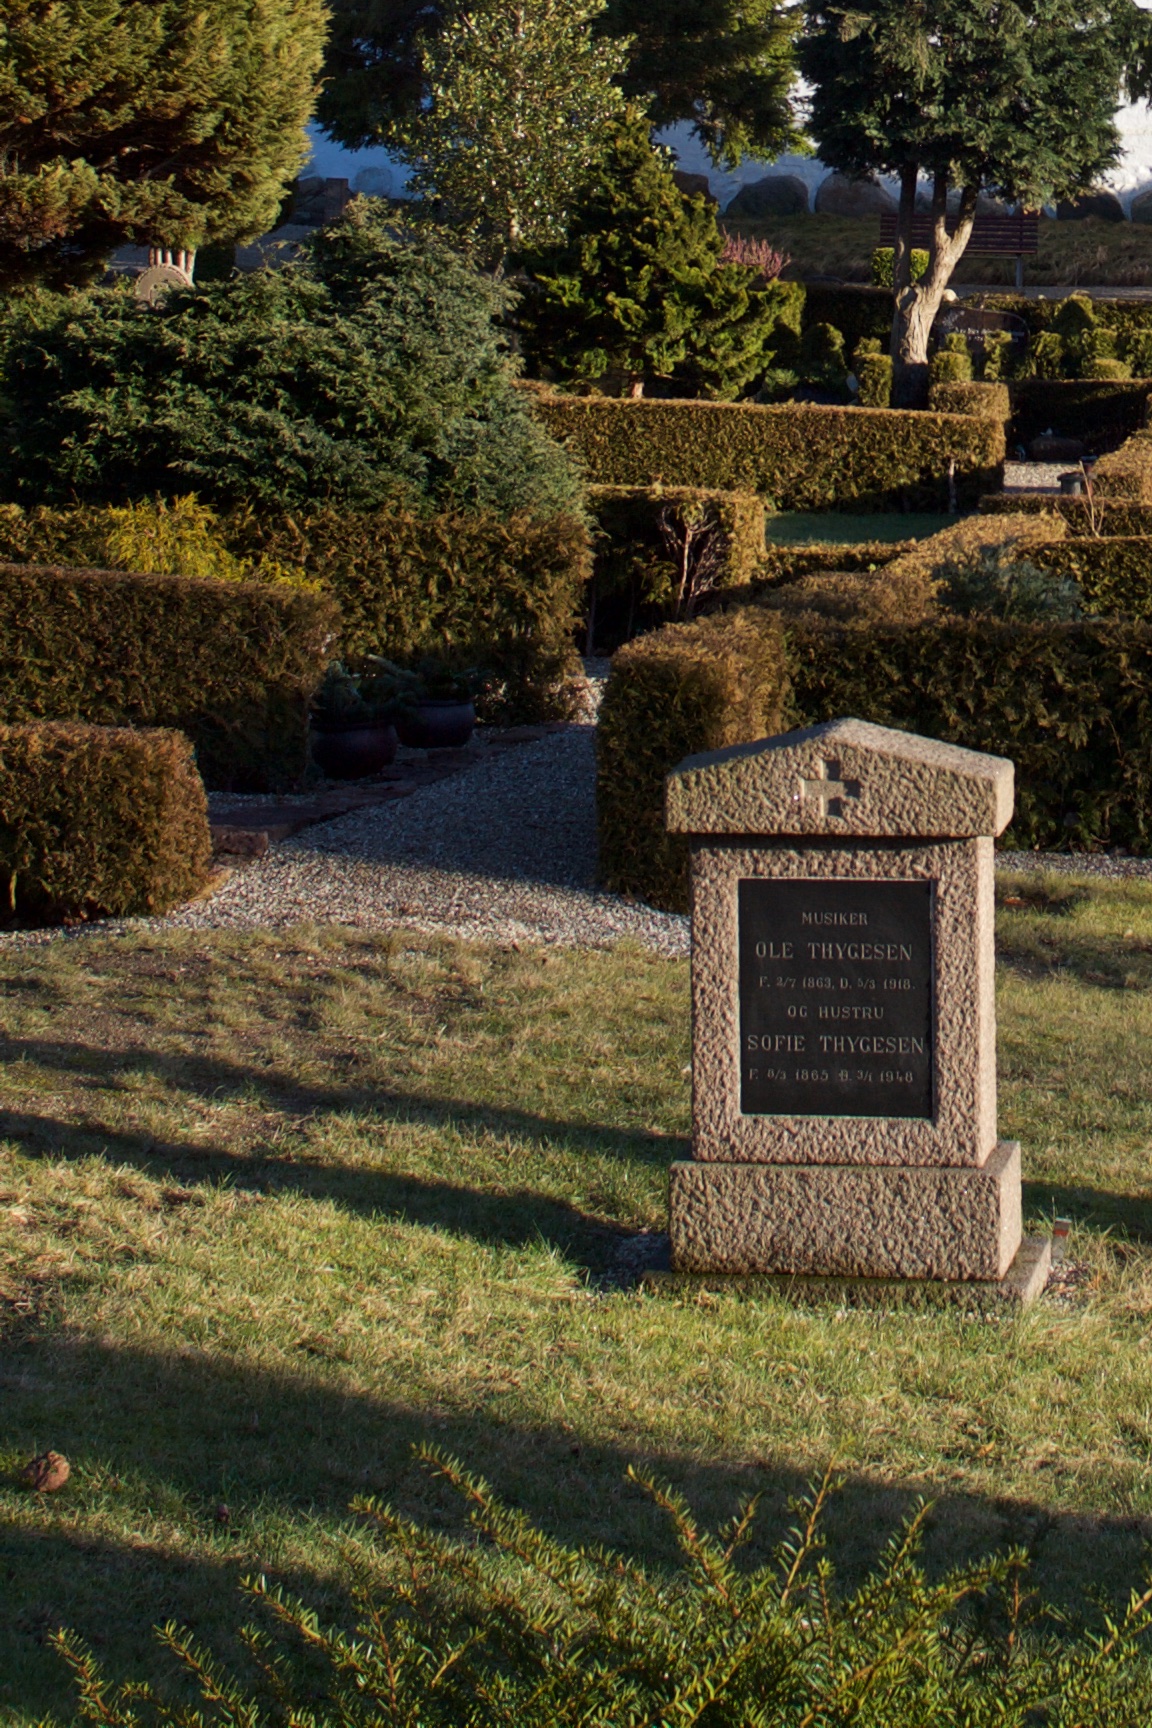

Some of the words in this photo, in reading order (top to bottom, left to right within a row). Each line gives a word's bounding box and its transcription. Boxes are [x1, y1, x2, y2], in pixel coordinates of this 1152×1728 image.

[802, 912, 868, 926] MUSIKER
[755, 941, 794, 959] OLE
[807, 942, 913, 961] THYGESEN
[759, 976, 770, 987] F.
[840, 978, 852, 989] D.
[787, 1005, 808, 1018] OG
[819, 1006, 884, 1019] HUSTRU
[747, 1034, 807, 1052] SOFIE
[819, 1035, 924, 1054] THYGESEN
[795, 1069, 829, 1081] 1865
